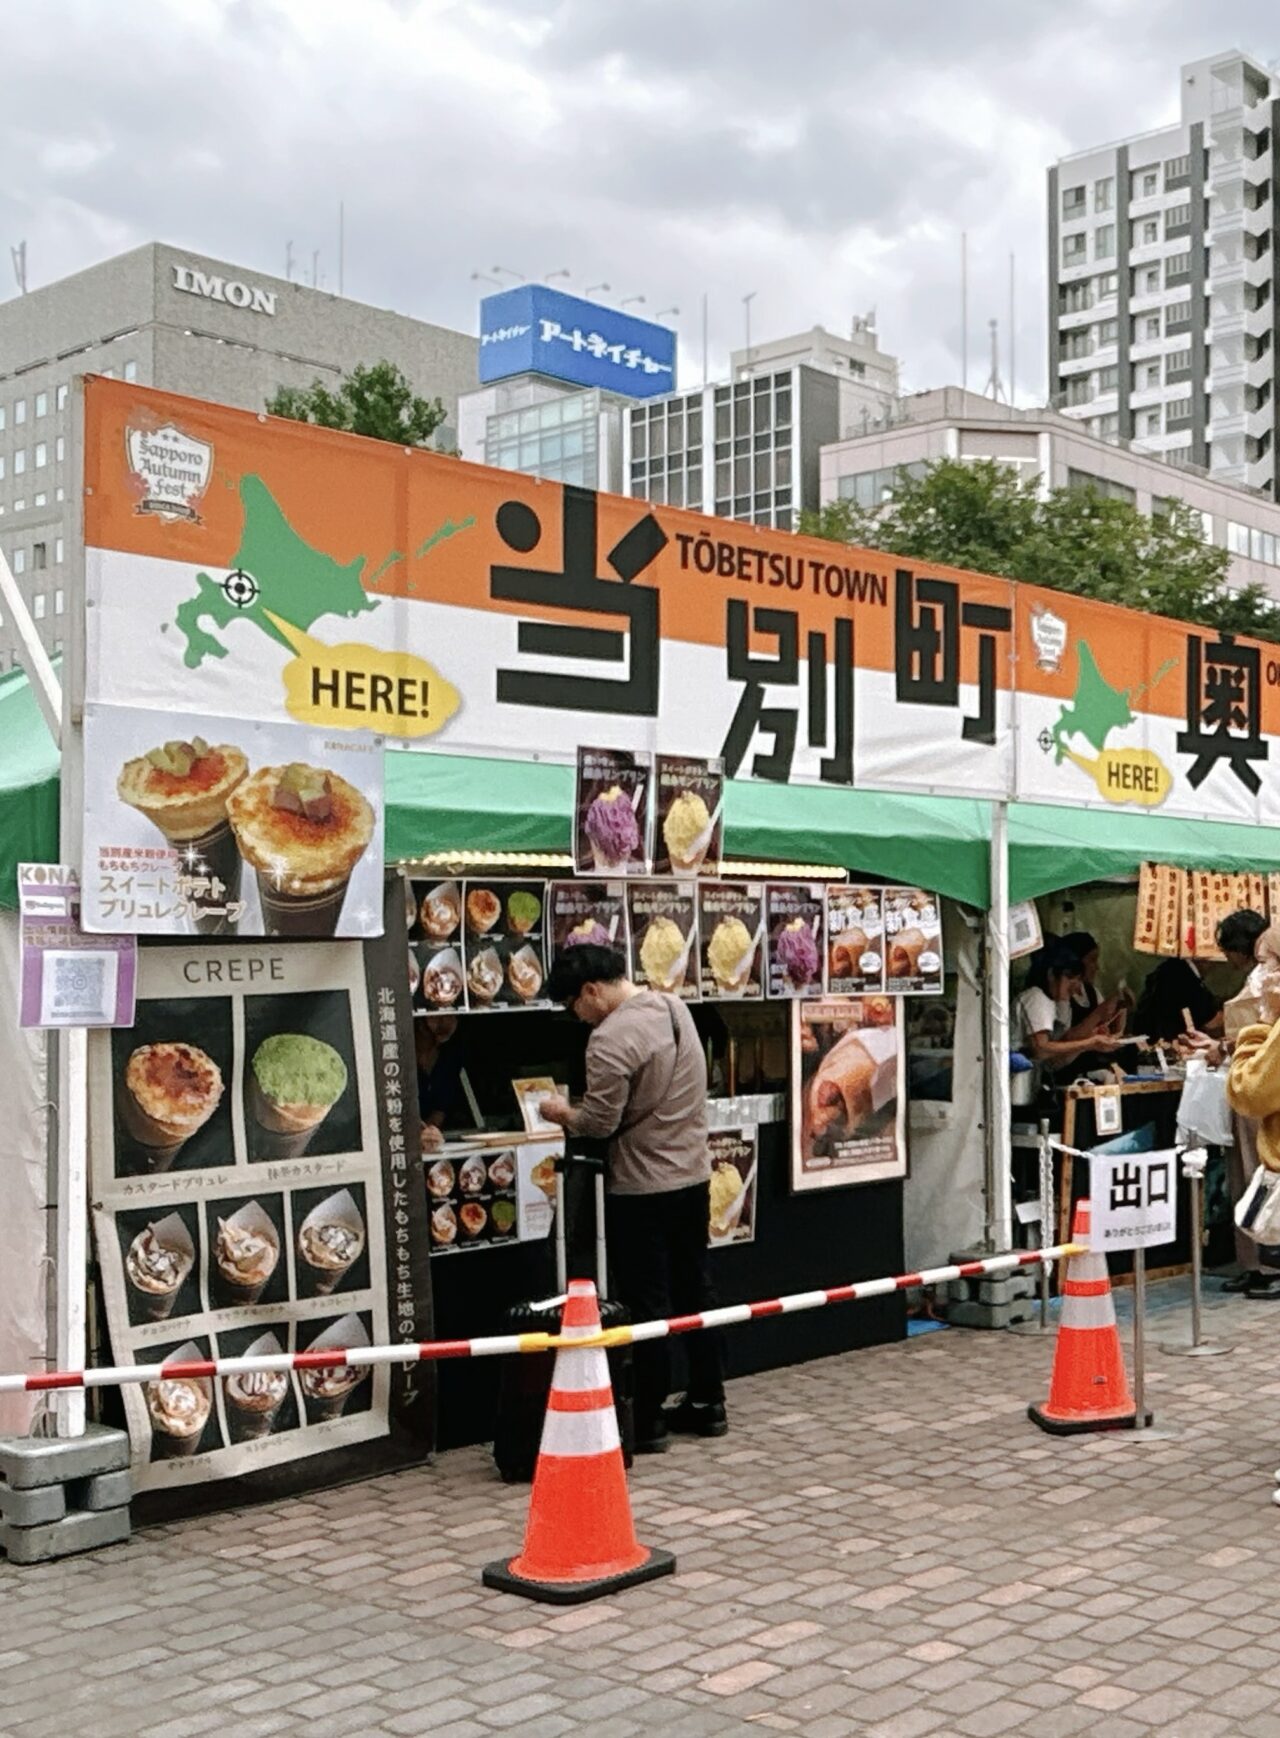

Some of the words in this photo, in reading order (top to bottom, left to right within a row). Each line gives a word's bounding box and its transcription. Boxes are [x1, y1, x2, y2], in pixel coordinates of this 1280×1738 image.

[171, 265, 278, 316] IMON
[539, 319, 672, 374] アートネイチャー
[139, 439, 203, 465] Sapporo
[139, 458, 201, 484] Autumn
[675, 531, 805, 591] TŌBETSU
[808, 561, 888, 607] TOWN
[490, 484, 1012, 786] 当別町
[310, 665, 430, 718] HERE!
[1107, 763, 1159, 792] HERE!
[99, 875, 226, 899] スイートポテト
[99, 900, 246, 922] ブリュレクレープ
[183, 958, 285, 983] CREPE
[123, 1175, 228, 1195] カスタードブリュレ
[1110, 1163, 1168, 1210] 出口
